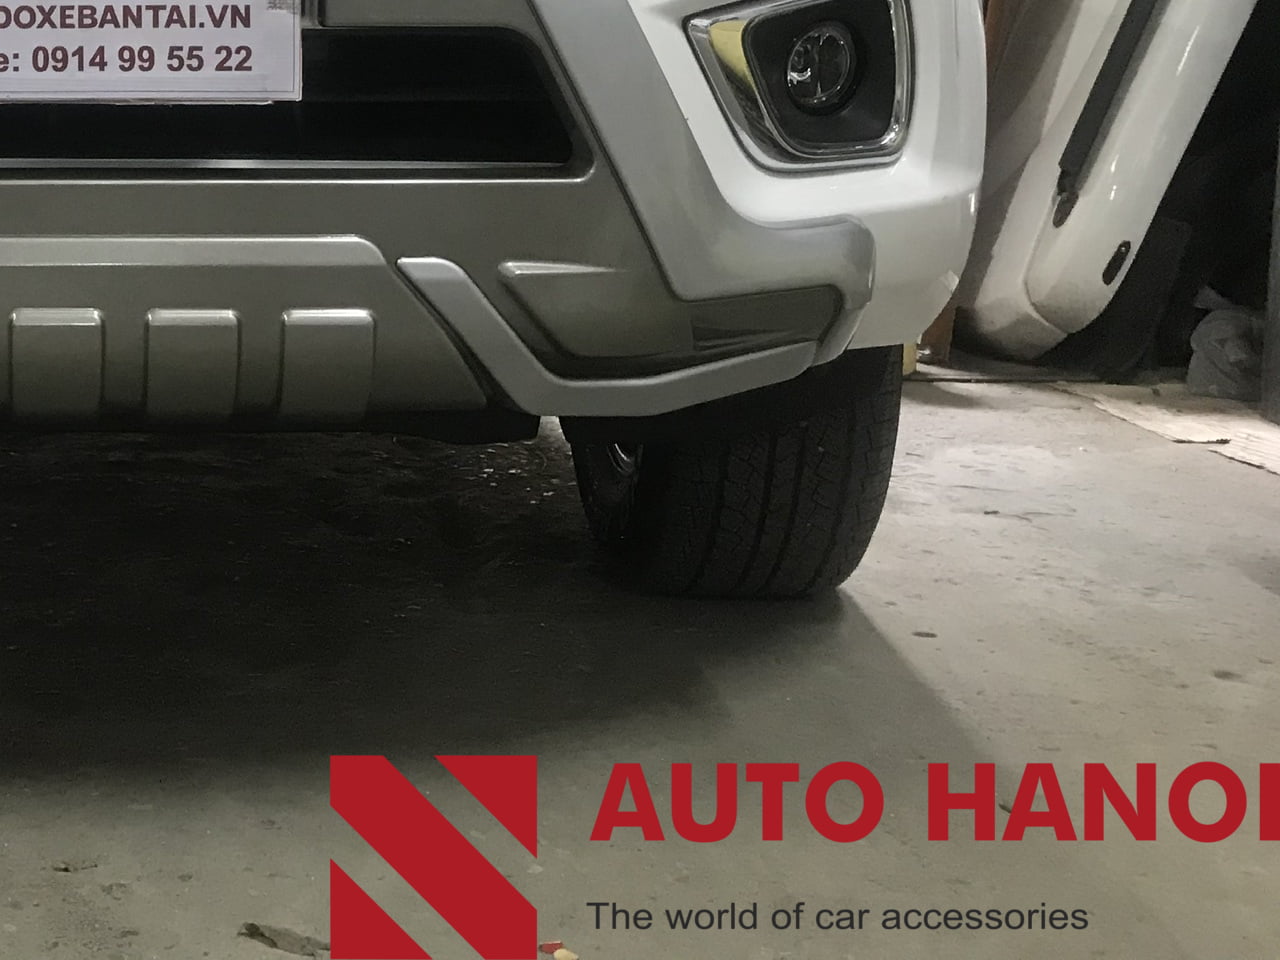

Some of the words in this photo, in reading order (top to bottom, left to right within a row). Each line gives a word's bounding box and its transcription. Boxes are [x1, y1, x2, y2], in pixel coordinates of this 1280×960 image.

[31, 46, 108, 73] 0914
[117, 46, 156, 73] 99
[166, 46, 205, 72] 55
[214, 46, 254, 72] 22
